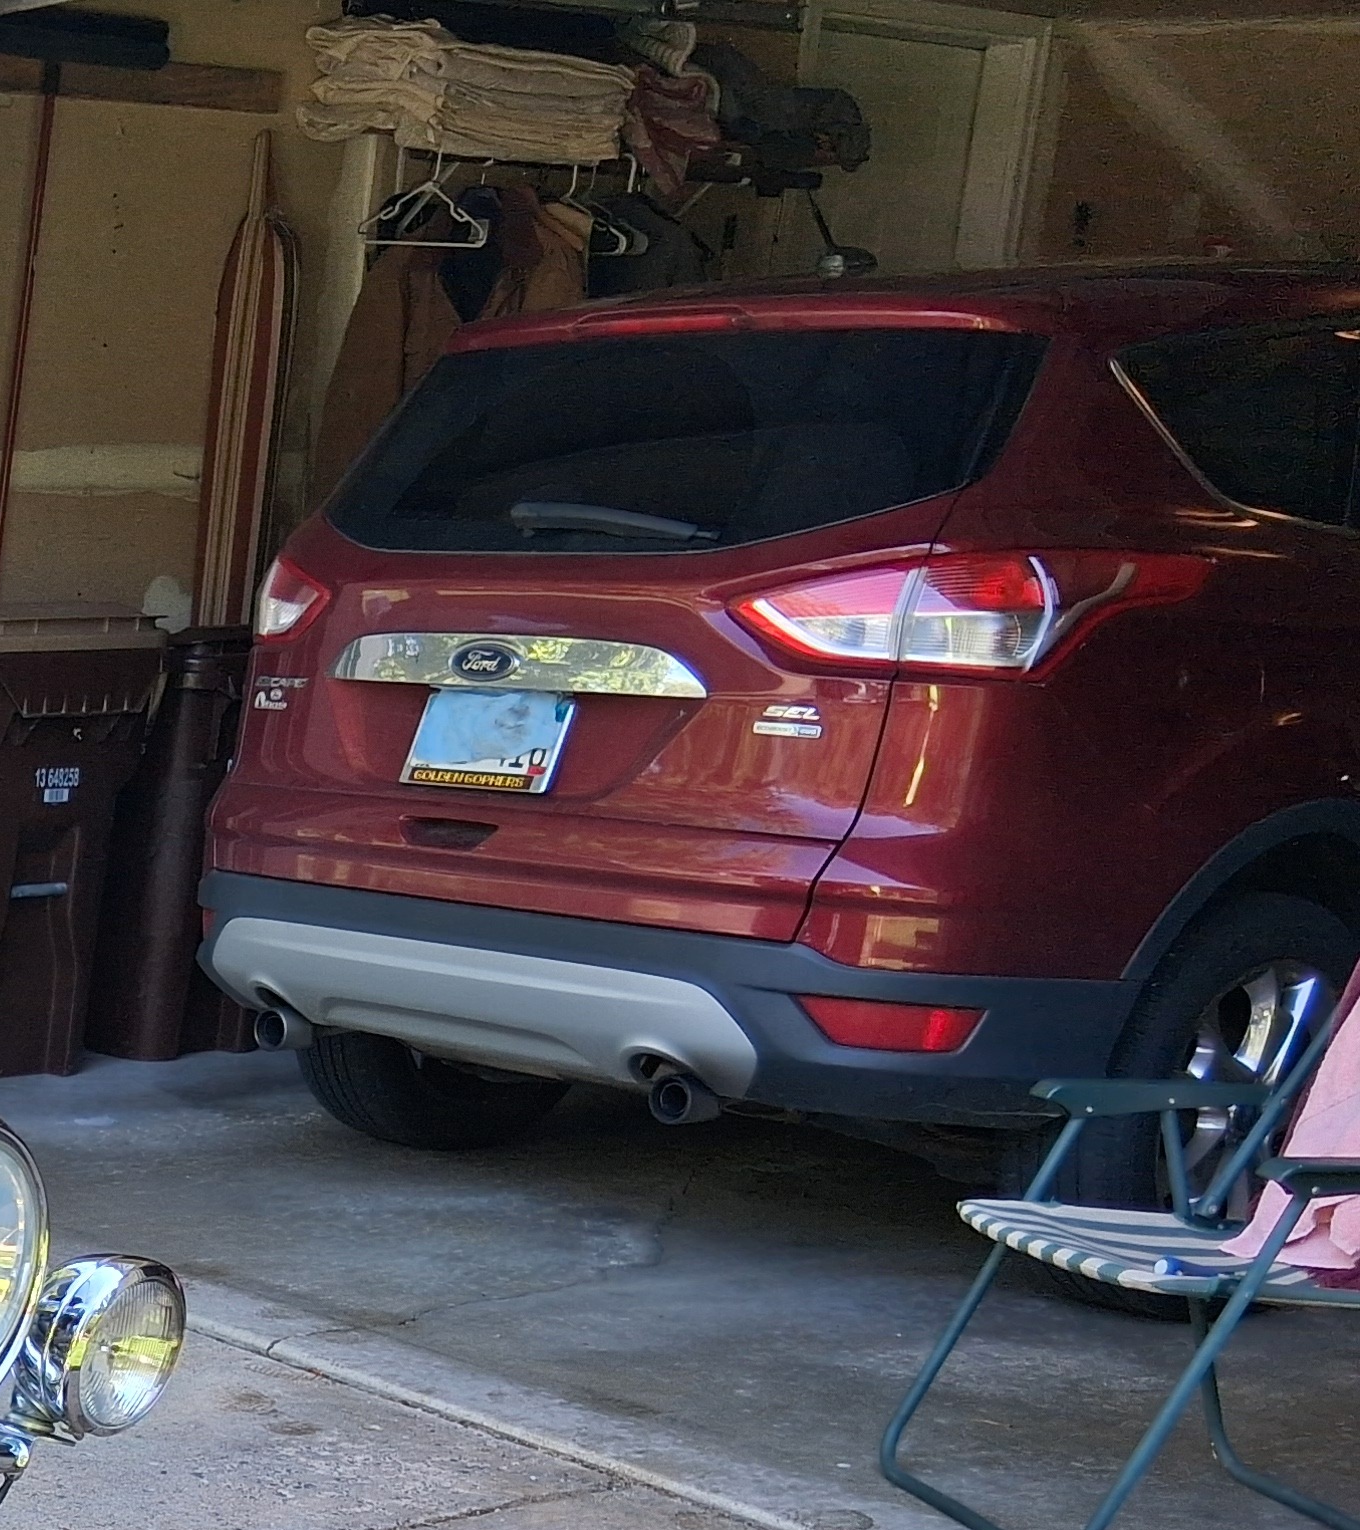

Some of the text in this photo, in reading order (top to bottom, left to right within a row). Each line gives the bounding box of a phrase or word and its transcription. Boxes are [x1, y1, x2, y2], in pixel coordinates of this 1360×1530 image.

[461, 650, 499, 673] Ford
[762, 705, 821, 720] SEL
[413, 768, 525, 788] GOLDEN GOPHERS
